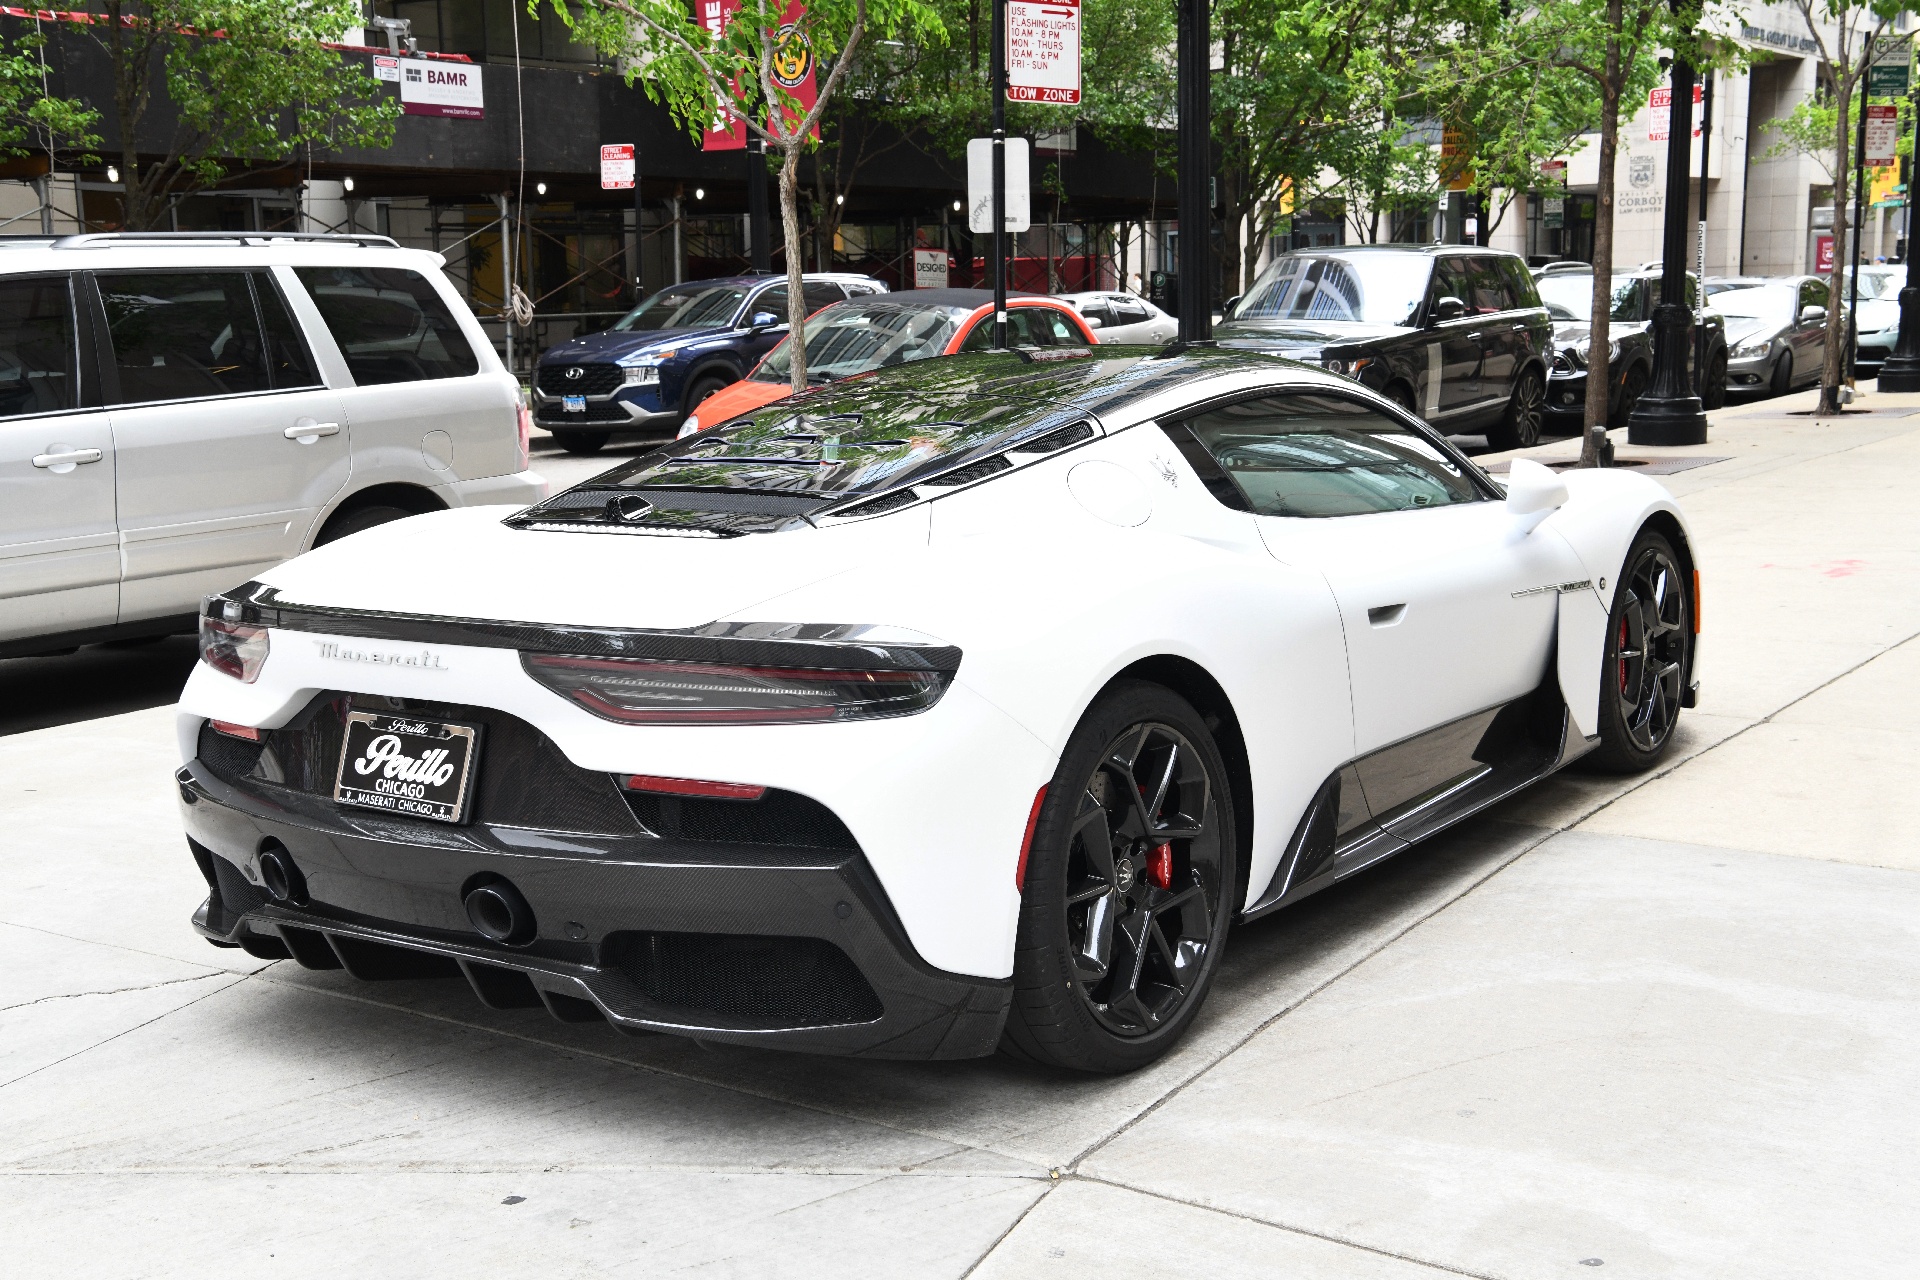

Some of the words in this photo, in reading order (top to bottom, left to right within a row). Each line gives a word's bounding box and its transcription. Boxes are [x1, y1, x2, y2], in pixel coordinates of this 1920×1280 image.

[1011, 7, 1026, 16] USE
[1011, 17, 1048, 28] FLASHING
[1050, 21, 1076, 30] LIGHTS
[1041, 30, 1045, 38] 8
[1048, 31, 1060, 39] PM
[1011, 38, 1028, 47] MON
[1038, 40, 1063, 50] THURS
[1041, 51, 1045, 59] 6
[1047, 52, 1059, 60] PM
[1011, 59, 1024, 68] FRI
[1032, 61, 1048, 69] SUN
[427, 70, 467, 86] BAMR
[1011, 86, 1036, 99] TOW
[1043, 89, 1073, 102] ZONE
[1619, 197, 1664, 206] CORBOY
[916, 262, 947, 273] DESIGNED
[1156, 275, 1163, 284] P
[1563, 580, 1590, 591] MC20
[312, 640, 448, 670] Maserati
[388, 720, 429, 734] Perillo
[354, 734, 454, 787] Perillo
[375, 779, 425, 798] CHICAGO
[358, 793, 396, 808] MASERATI
[398, 800, 433, 814] CHICAGO
